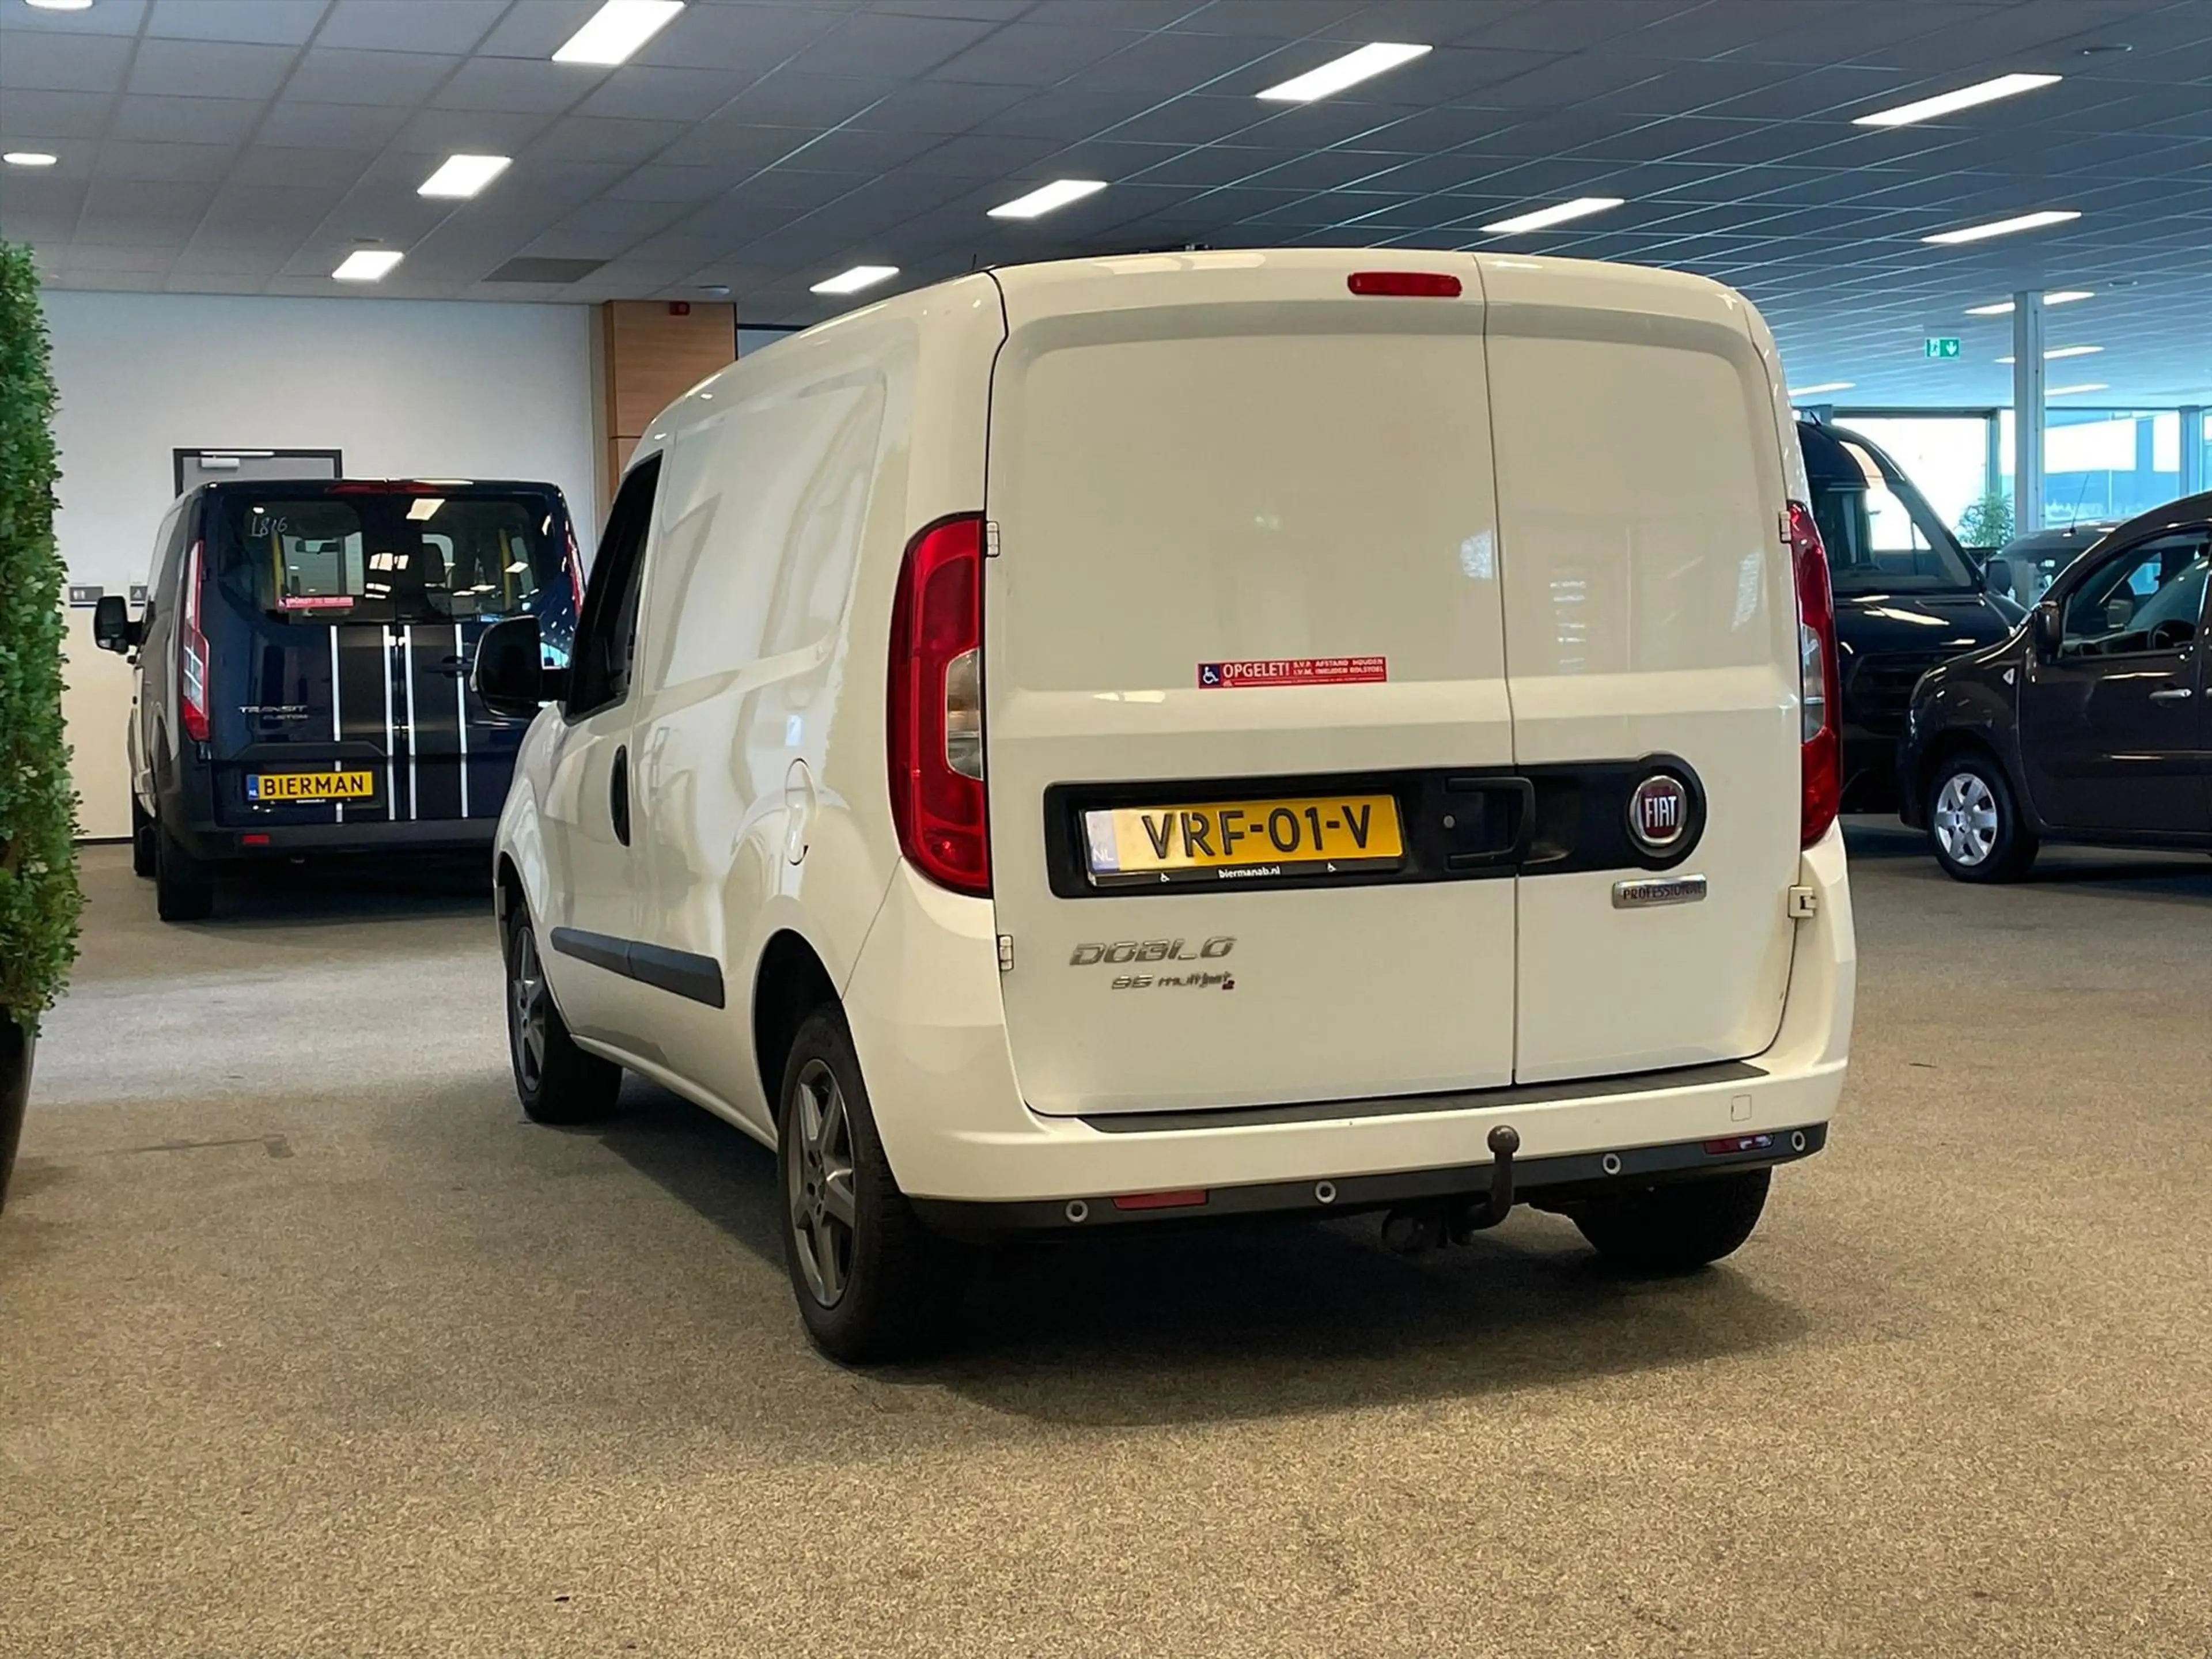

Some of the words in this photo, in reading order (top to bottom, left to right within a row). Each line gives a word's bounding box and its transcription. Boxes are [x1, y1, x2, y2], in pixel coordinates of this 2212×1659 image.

[1223, 662, 1290, 678] OPGELET!
[264, 775, 364, 796] BIERMAN
[1644, 796, 1677, 828] FIAT
[1142, 804, 1370, 859] VRF-01-V
[1094, 849, 1114, 862] NL
[1218, 865, 1281, 878] biermanab.nl
